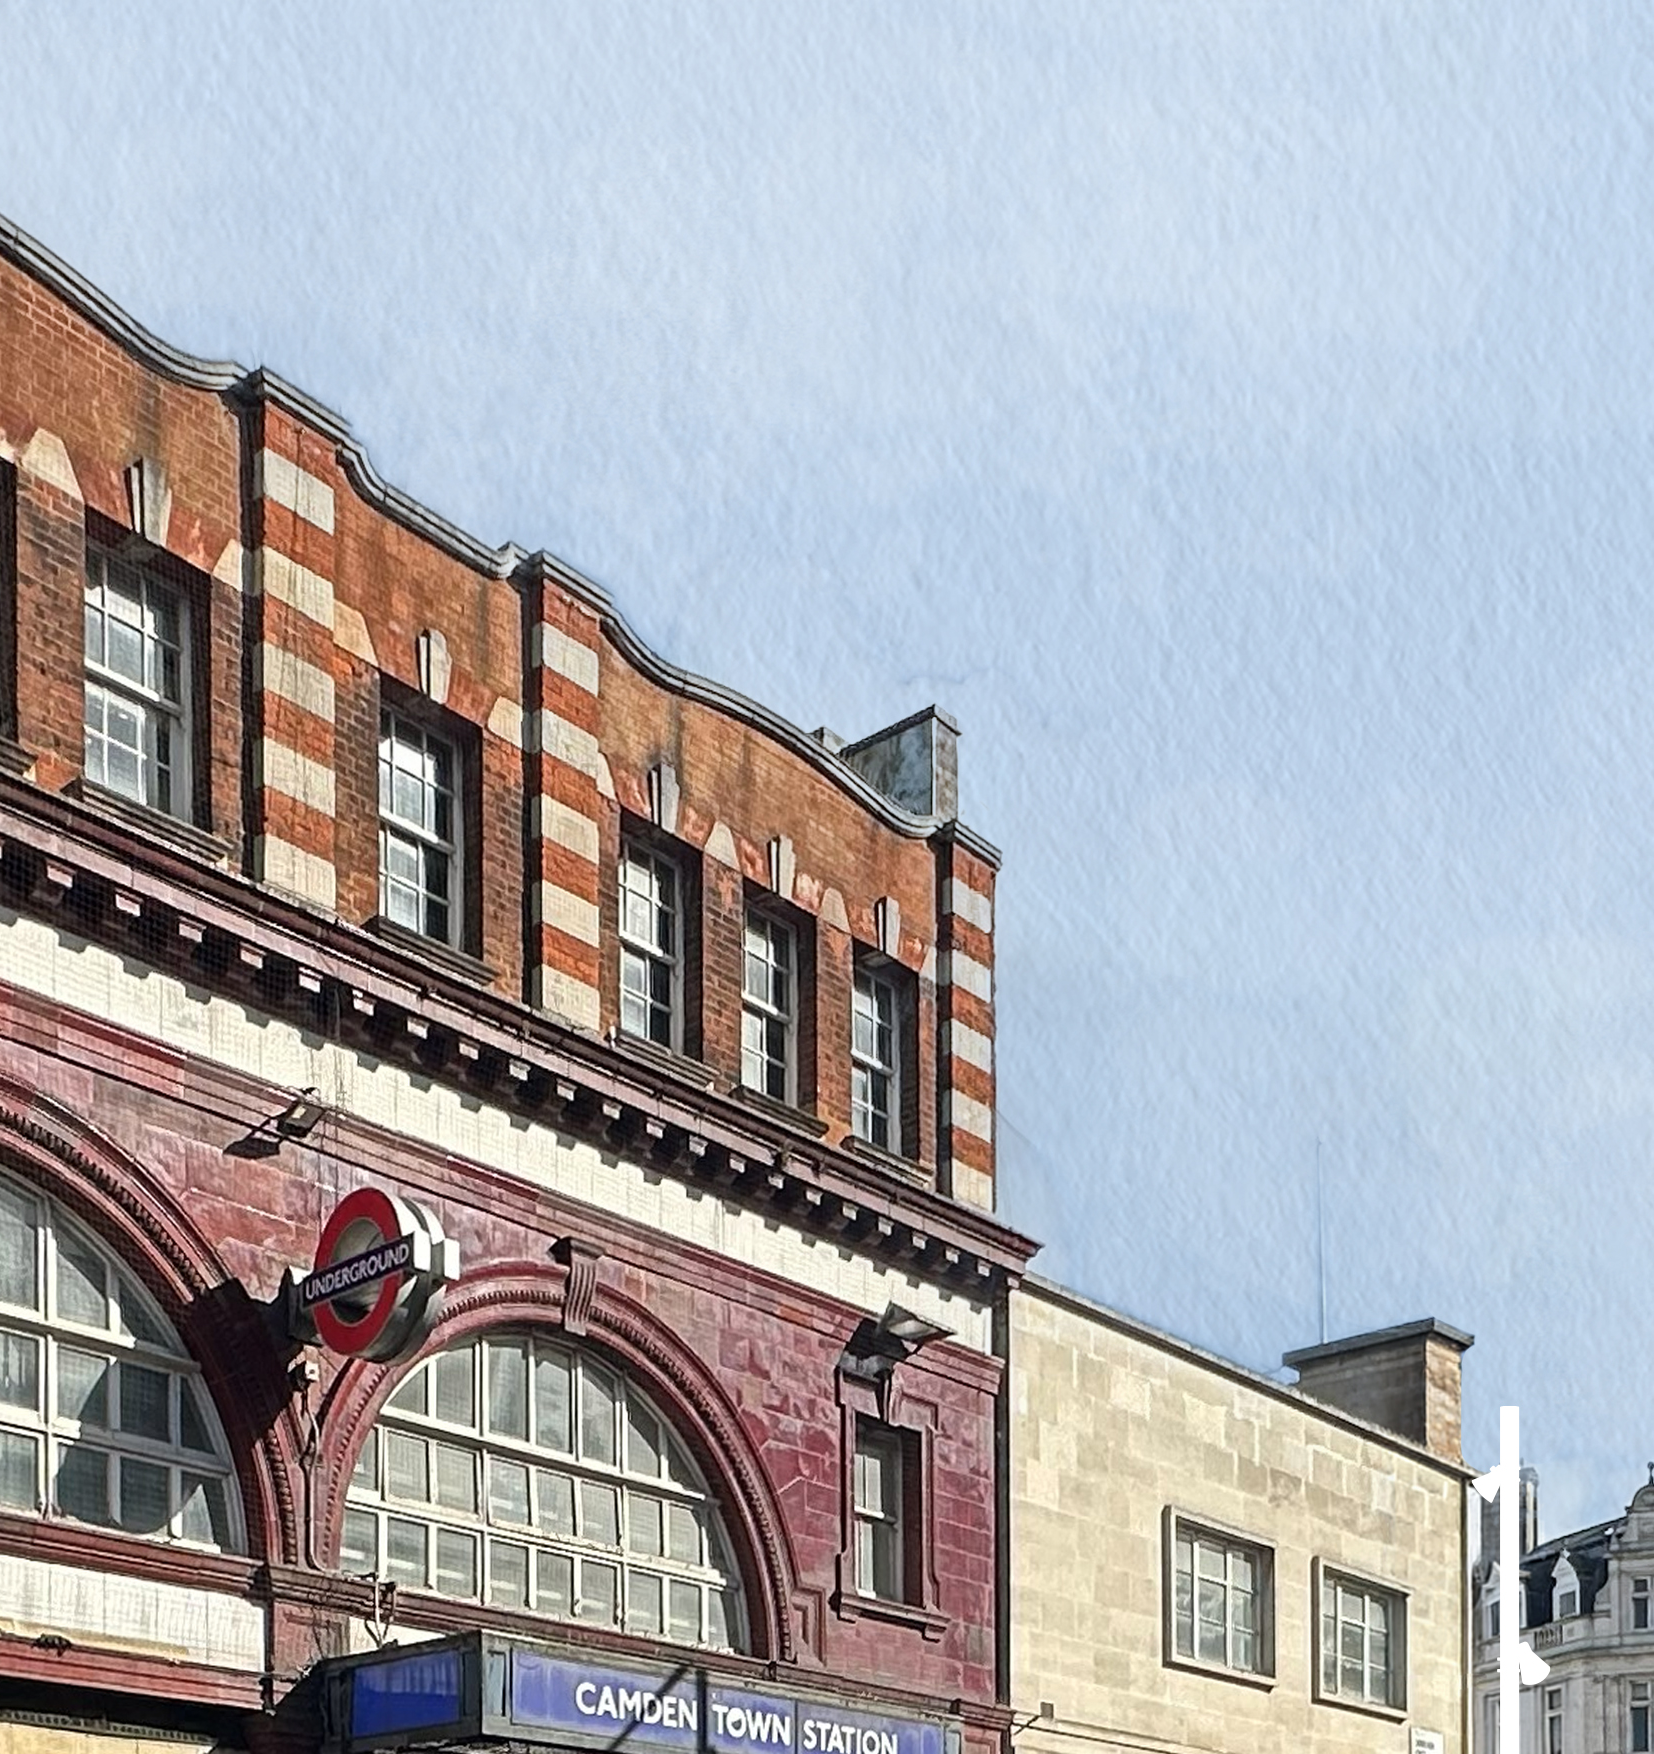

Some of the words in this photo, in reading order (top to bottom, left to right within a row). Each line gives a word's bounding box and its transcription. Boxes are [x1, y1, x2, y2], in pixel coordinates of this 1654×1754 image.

[304, 1243, 410, 1300] UNDERGROUND
[575, 1682, 697, 1732] CAMDEN
[712, 1703, 791, 1746] TOWN
